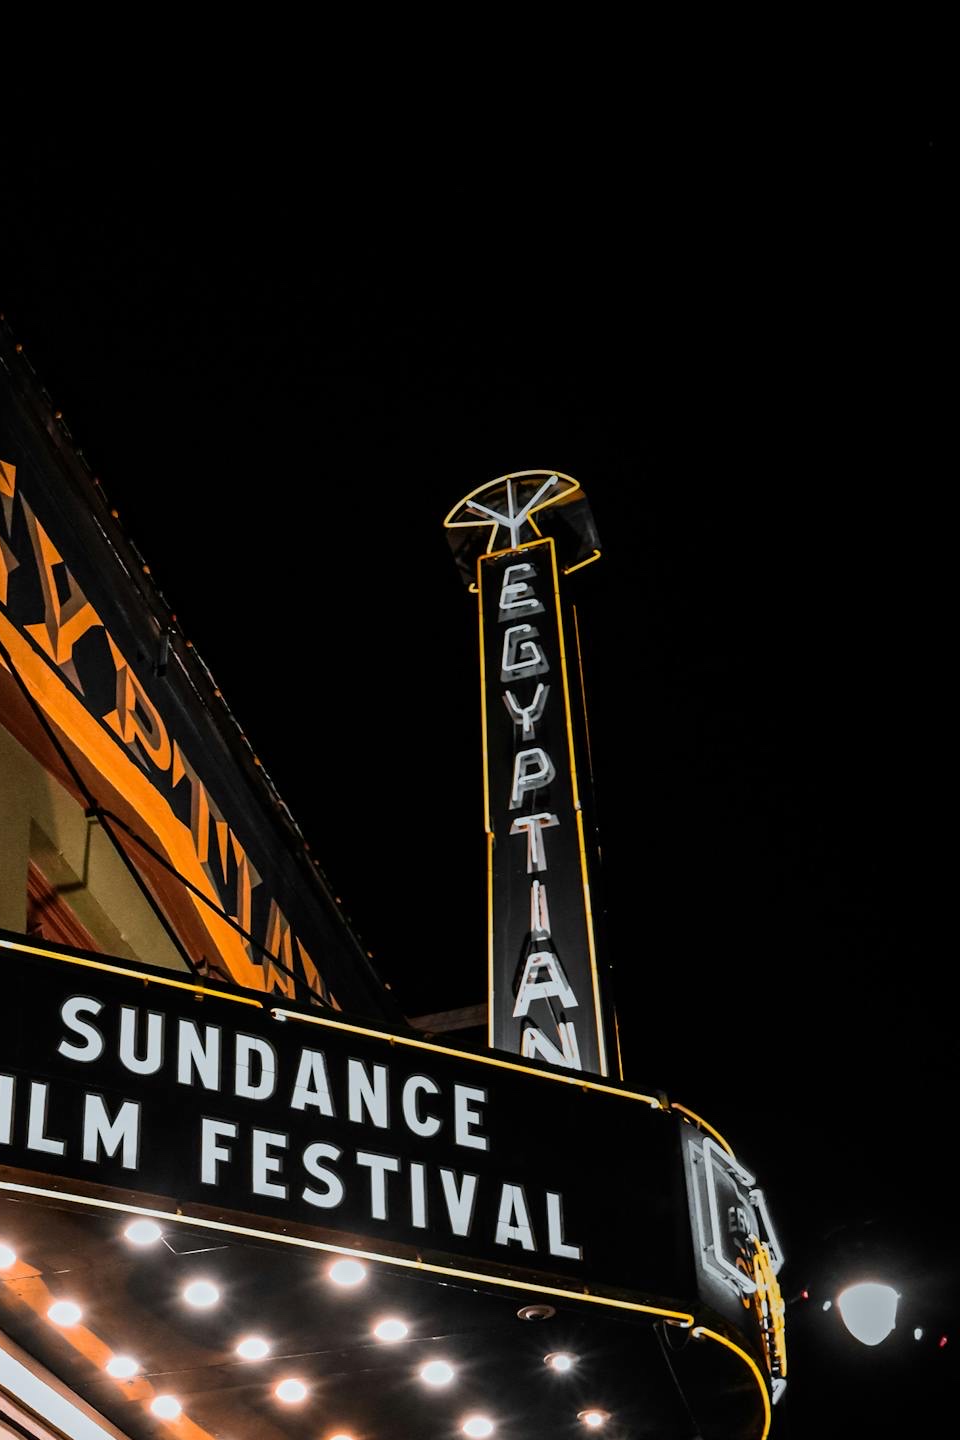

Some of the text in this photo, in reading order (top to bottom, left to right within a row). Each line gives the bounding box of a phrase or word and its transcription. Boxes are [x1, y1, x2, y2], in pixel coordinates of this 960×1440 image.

[496, 561, 582, 1071] EGYPTIAN
[57, 994, 490, 1152] SUNDANCE
[198, 1118, 585, 1262] FESTIVAL
